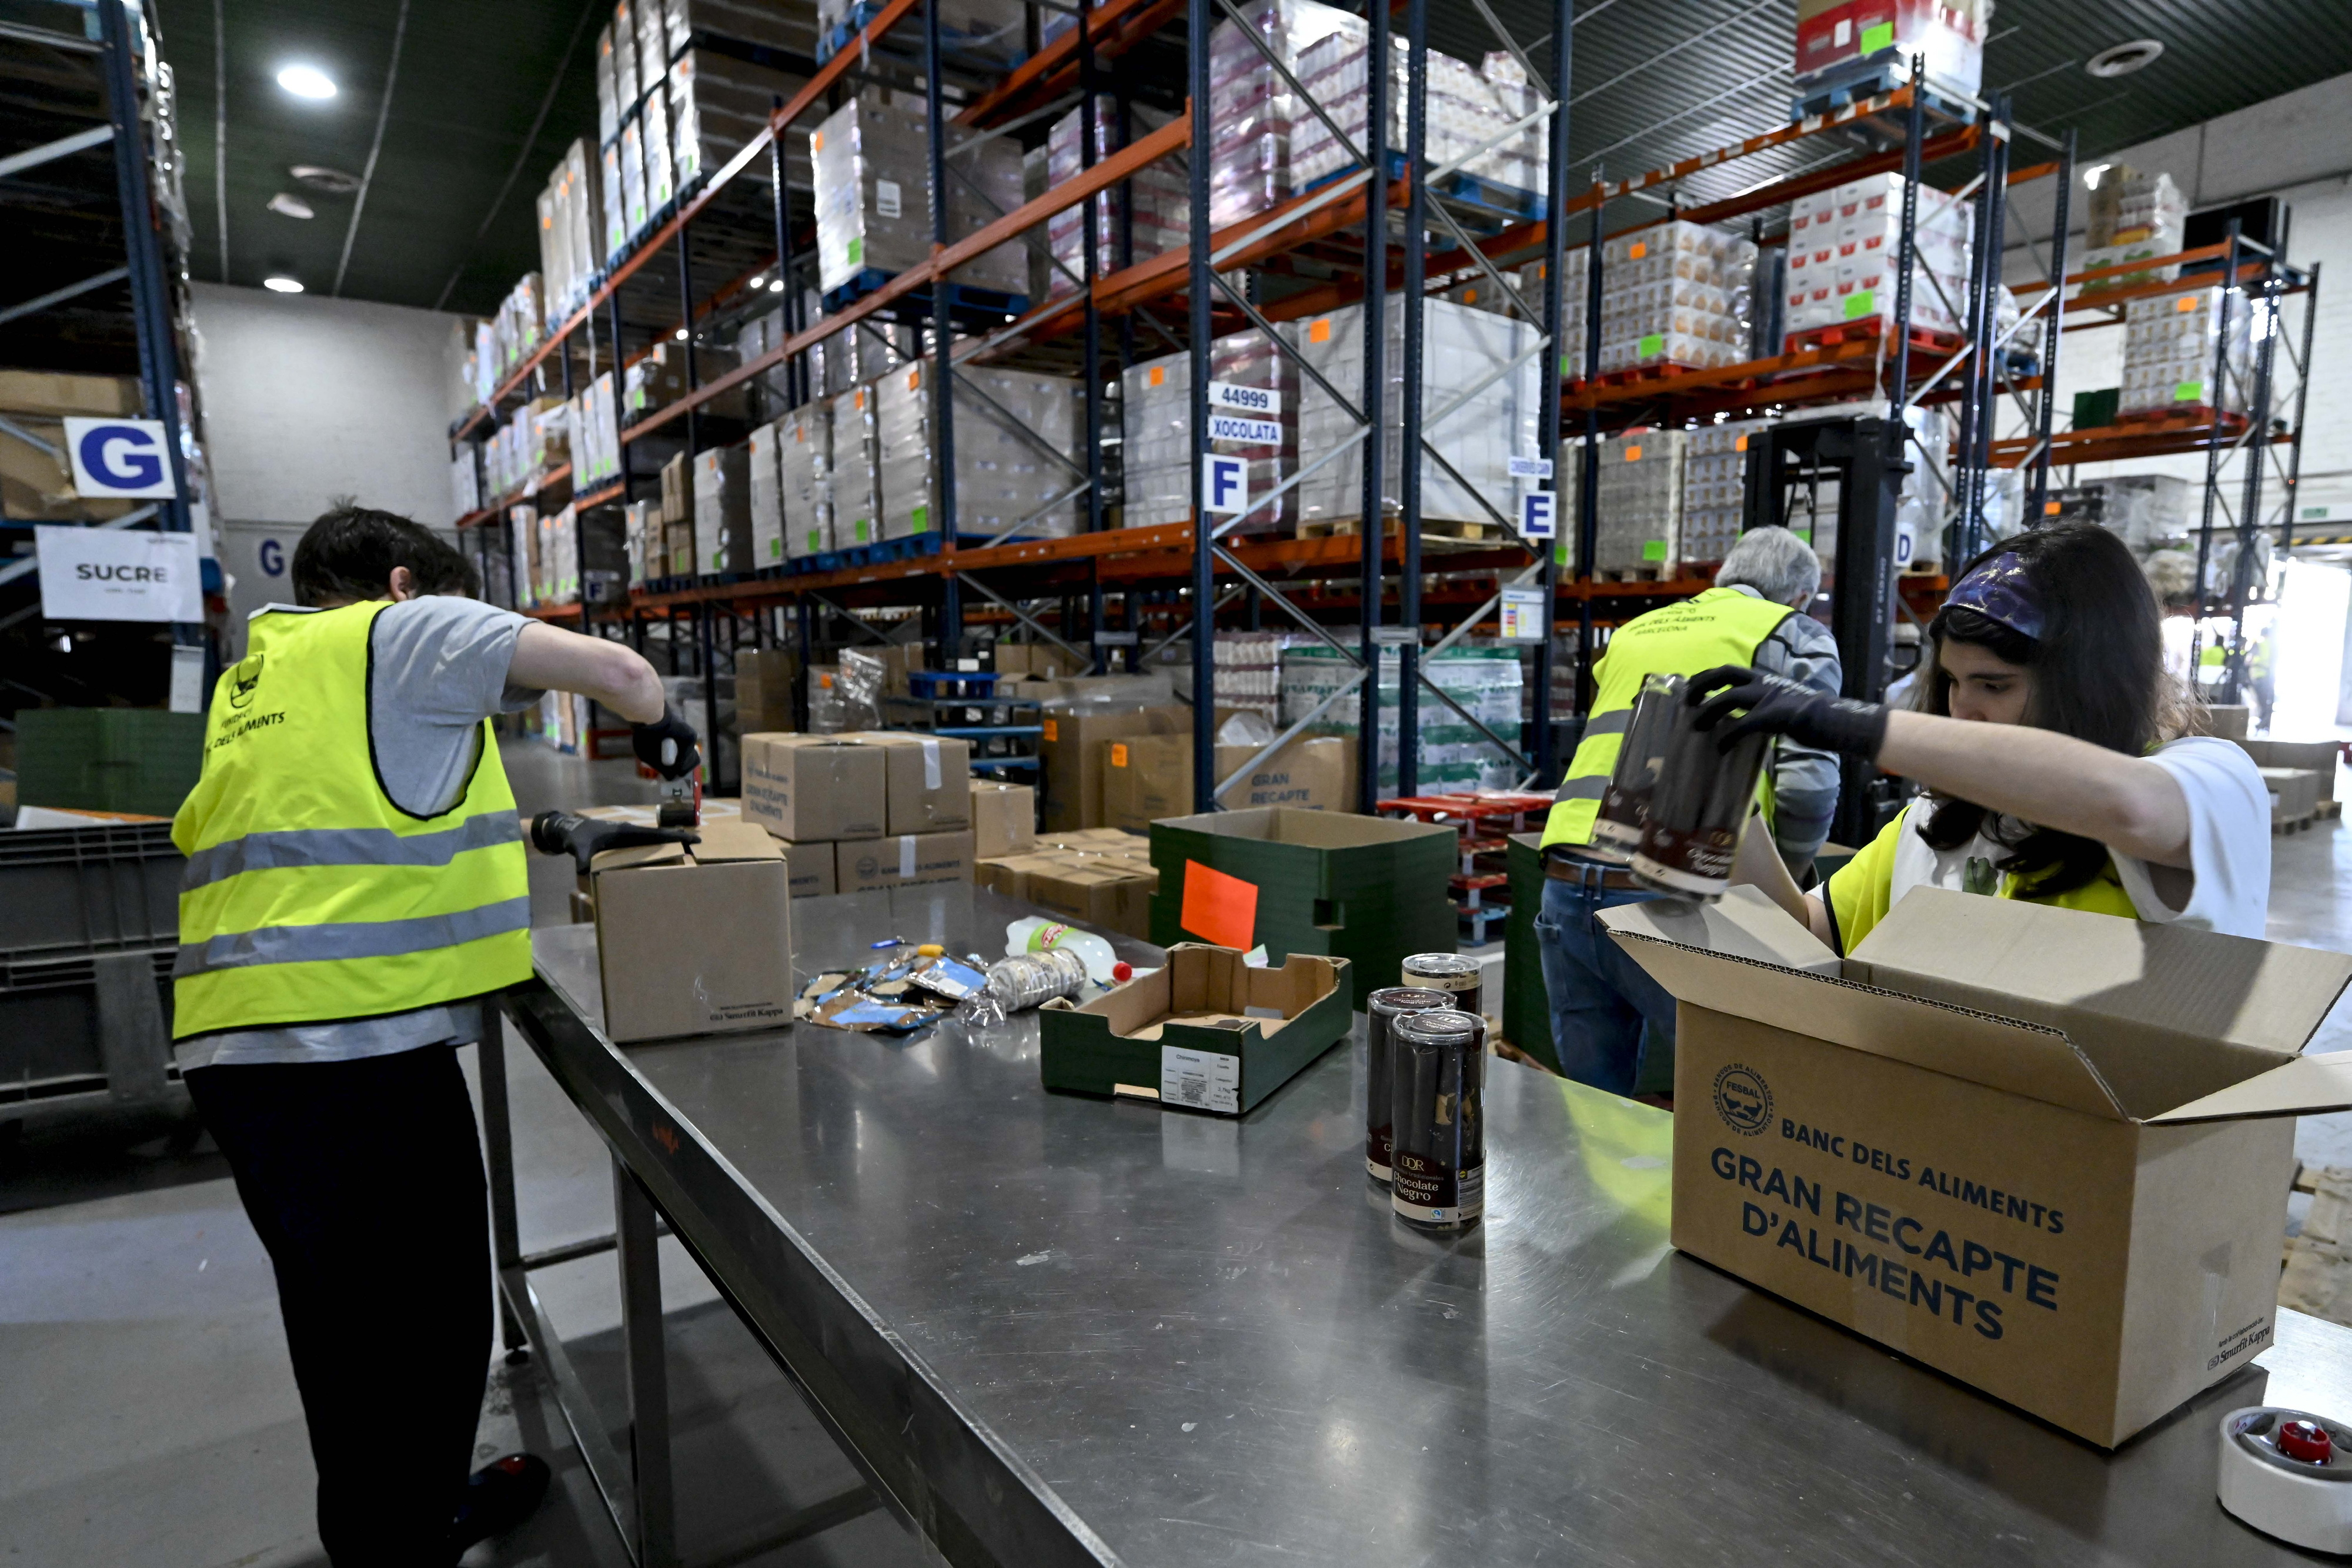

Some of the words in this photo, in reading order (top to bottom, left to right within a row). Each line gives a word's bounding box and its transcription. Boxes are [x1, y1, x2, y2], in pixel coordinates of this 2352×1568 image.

[1222, 387, 1268, 408] 44999
[1214, 419, 1278, 440] XOCOLATA
[79, 426, 164, 490] G
[1214, 461, 1240, 506] F
[1526, 496, 1549, 533] E
[261, 539, 285, 577] G
[1897, 534, 1910, 561] D
[76, 563, 168, 583] SUCRE
[1251, 773, 1289, 787] GRAN
[1251, 789, 1310, 804] RECAPTE
[1713, 1064, 1732, 1088] BANCOS
[1745, 1066, 1774, 1105] ALIMENTOS
[1726, 1081, 1760, 1099] FESBAL
[1732, 1125, 1741, 1134] DE
[1743, 1113, 1773, 1137] ALIMENTOS
[1402, 1155, 1424, 1172] DOR
[1394, 1171, 1439, 1192] Chocolate
[1408, 1171, 1444, 1181] tradicionales
[1782, 1118, 1844, 1158] BANC
[1853, 1142, 1910, 1181] DELS
[1919, 1167, 2064, 1235] ALIMENTS
[1397, 1182, 1431, 1201] Negro
[1712, 1147, 1821, 1216] GRAN
[1836, 1191, 2060, 1312] RECAPTE
[1742, 1201, 2004, 1340] D'ALIMENTS
[2220, 1338, 2248, 1363] Smurfit
[2248, 1326, 2270, 1346] Kappa
